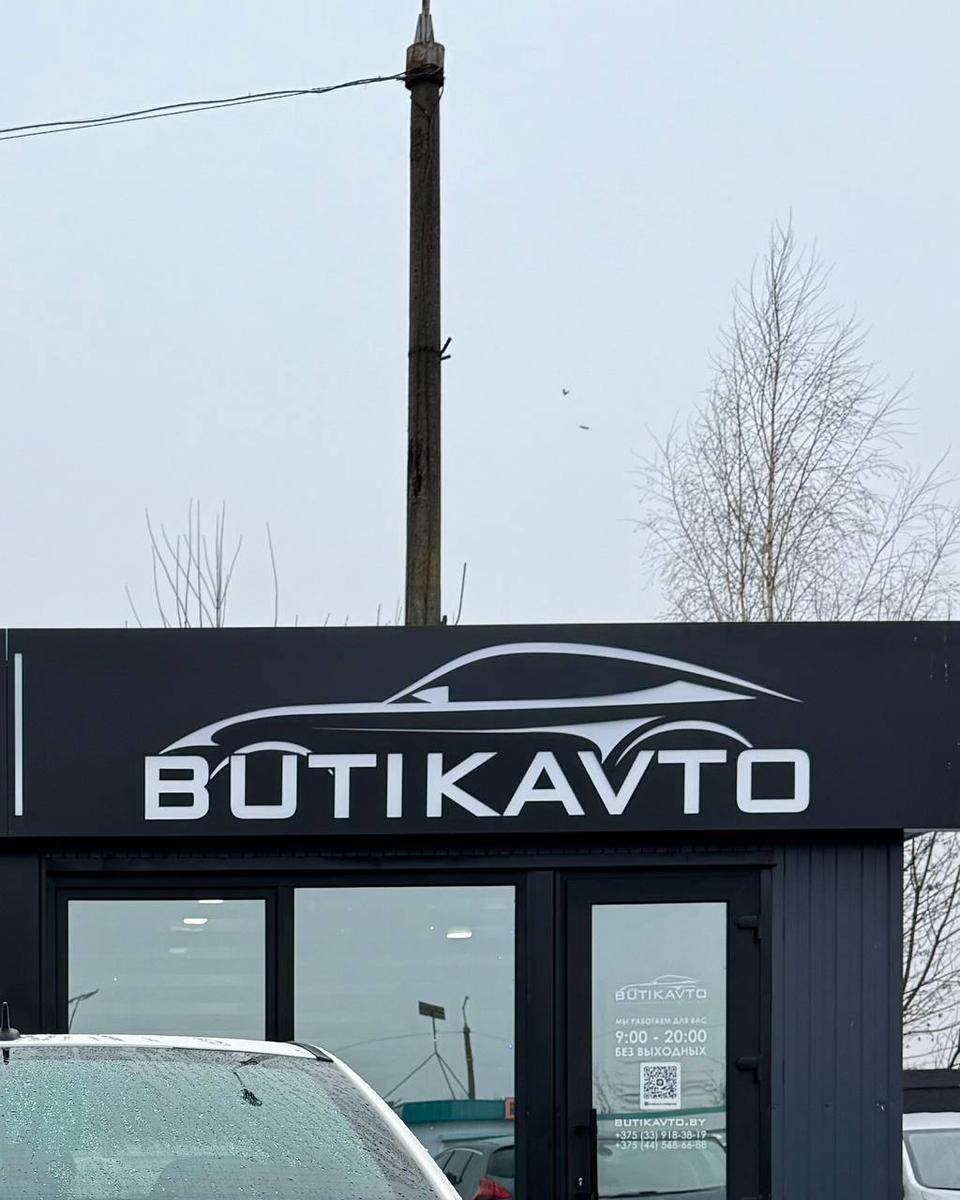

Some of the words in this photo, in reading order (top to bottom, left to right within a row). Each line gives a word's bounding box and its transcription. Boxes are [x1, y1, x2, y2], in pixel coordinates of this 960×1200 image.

[145, 748, 811, 820] BUTIKAVTO
[615, 989, 707, 1000] BUTIKAVTO
[616, 1030, 648, 1043] 9:00
[664, 1029, 707, 1043] 20:00
[616, 1047, 634, 1057] БЕЗ
[637, 1046, 707, 1056] ВЫХОДНЫХ
[615, 1118, 706, 1127] BUTIKAVTO.BY
[616, 1130, 638, 1139] +375
[641, 1130, 658, 1141] (33)
[661, 1130, 707, 1139] 918-38-19
